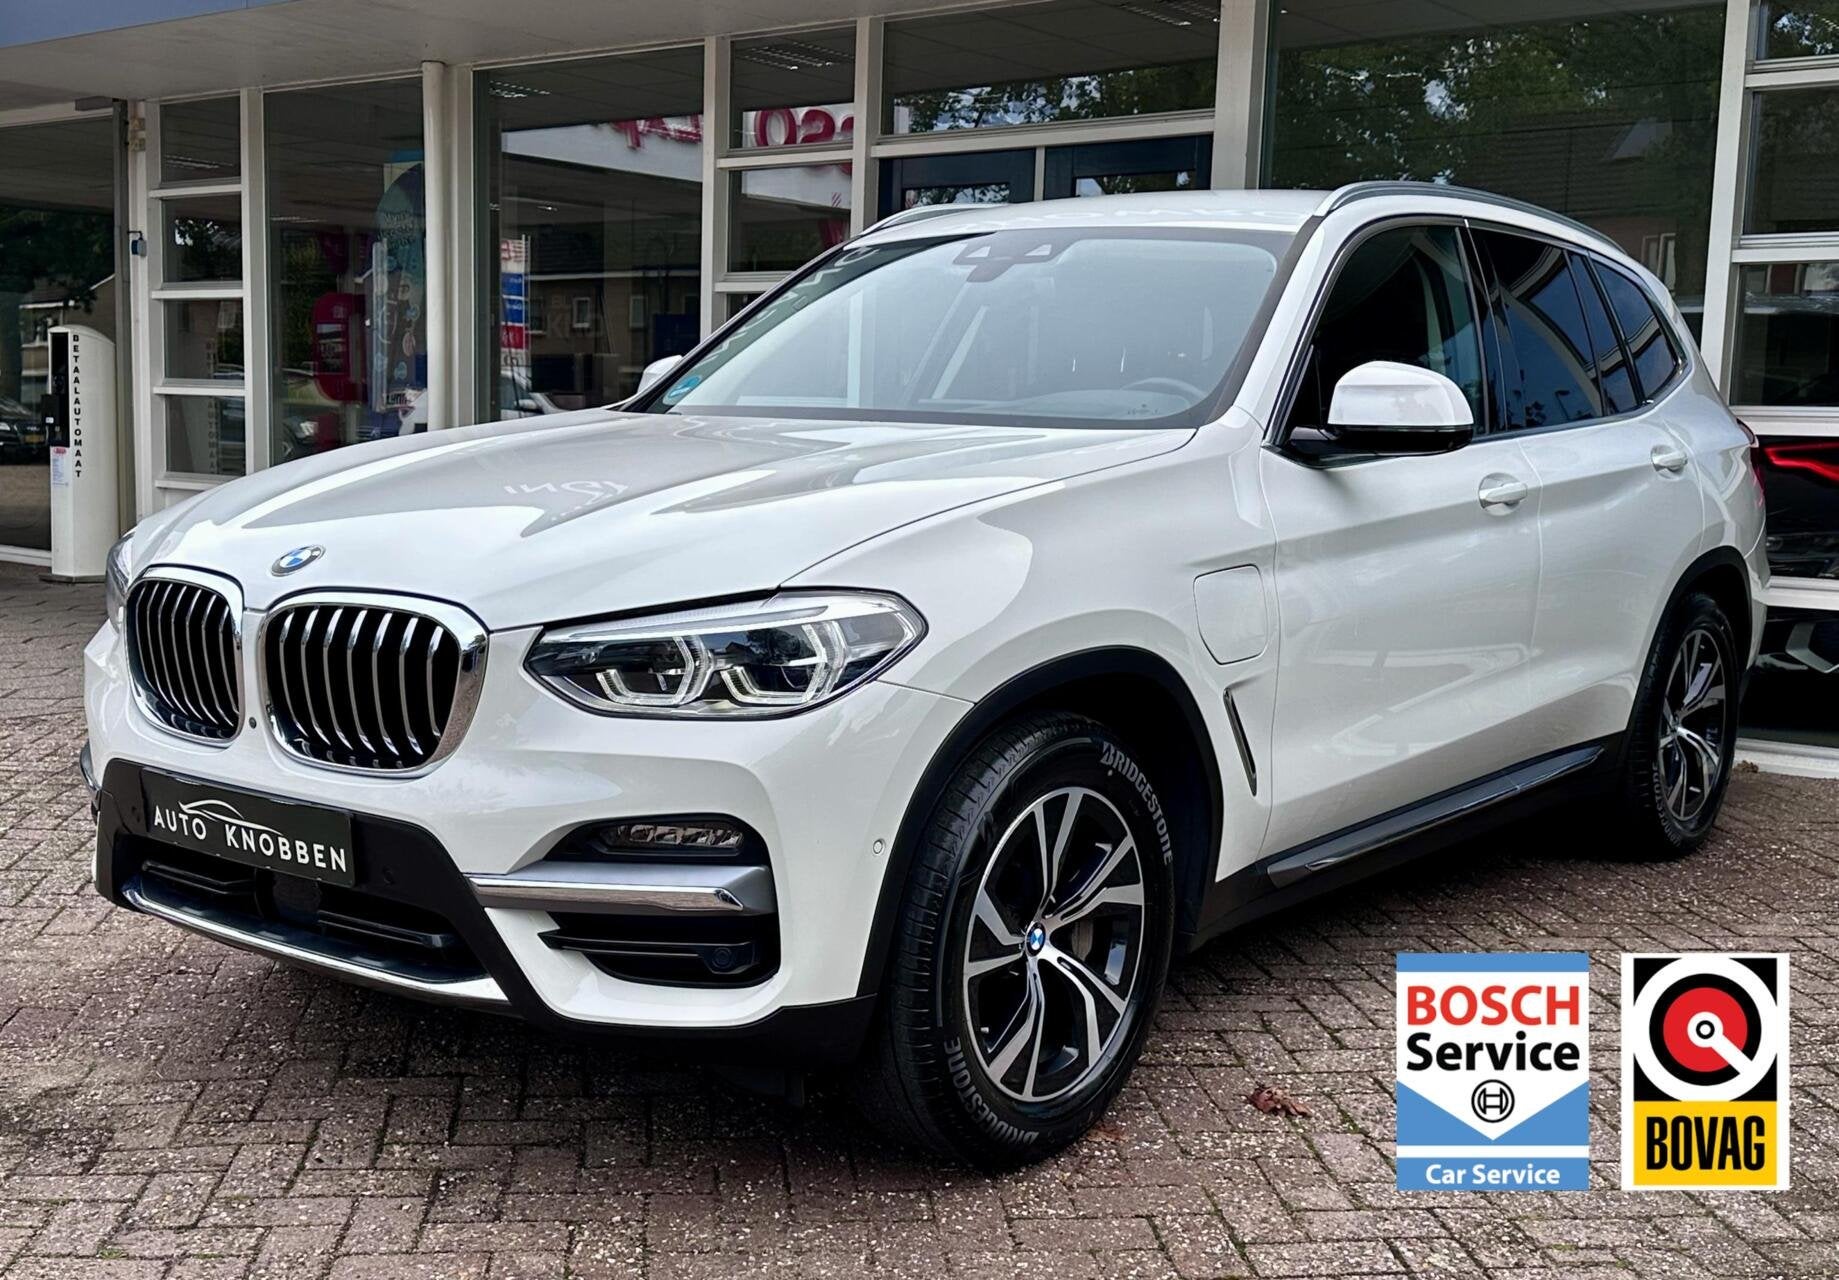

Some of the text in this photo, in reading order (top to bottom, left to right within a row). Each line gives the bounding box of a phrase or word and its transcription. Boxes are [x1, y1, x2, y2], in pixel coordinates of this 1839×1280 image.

[72, 334, 83, 478] BETAALAUTOMAAT
[153, 804, 348, 873] AUTO KNOBBEN
[1100, 741, 1174, 866] BRIDGESTONE
[943, 1036, 1040, 1145] BRIDGESTONE
